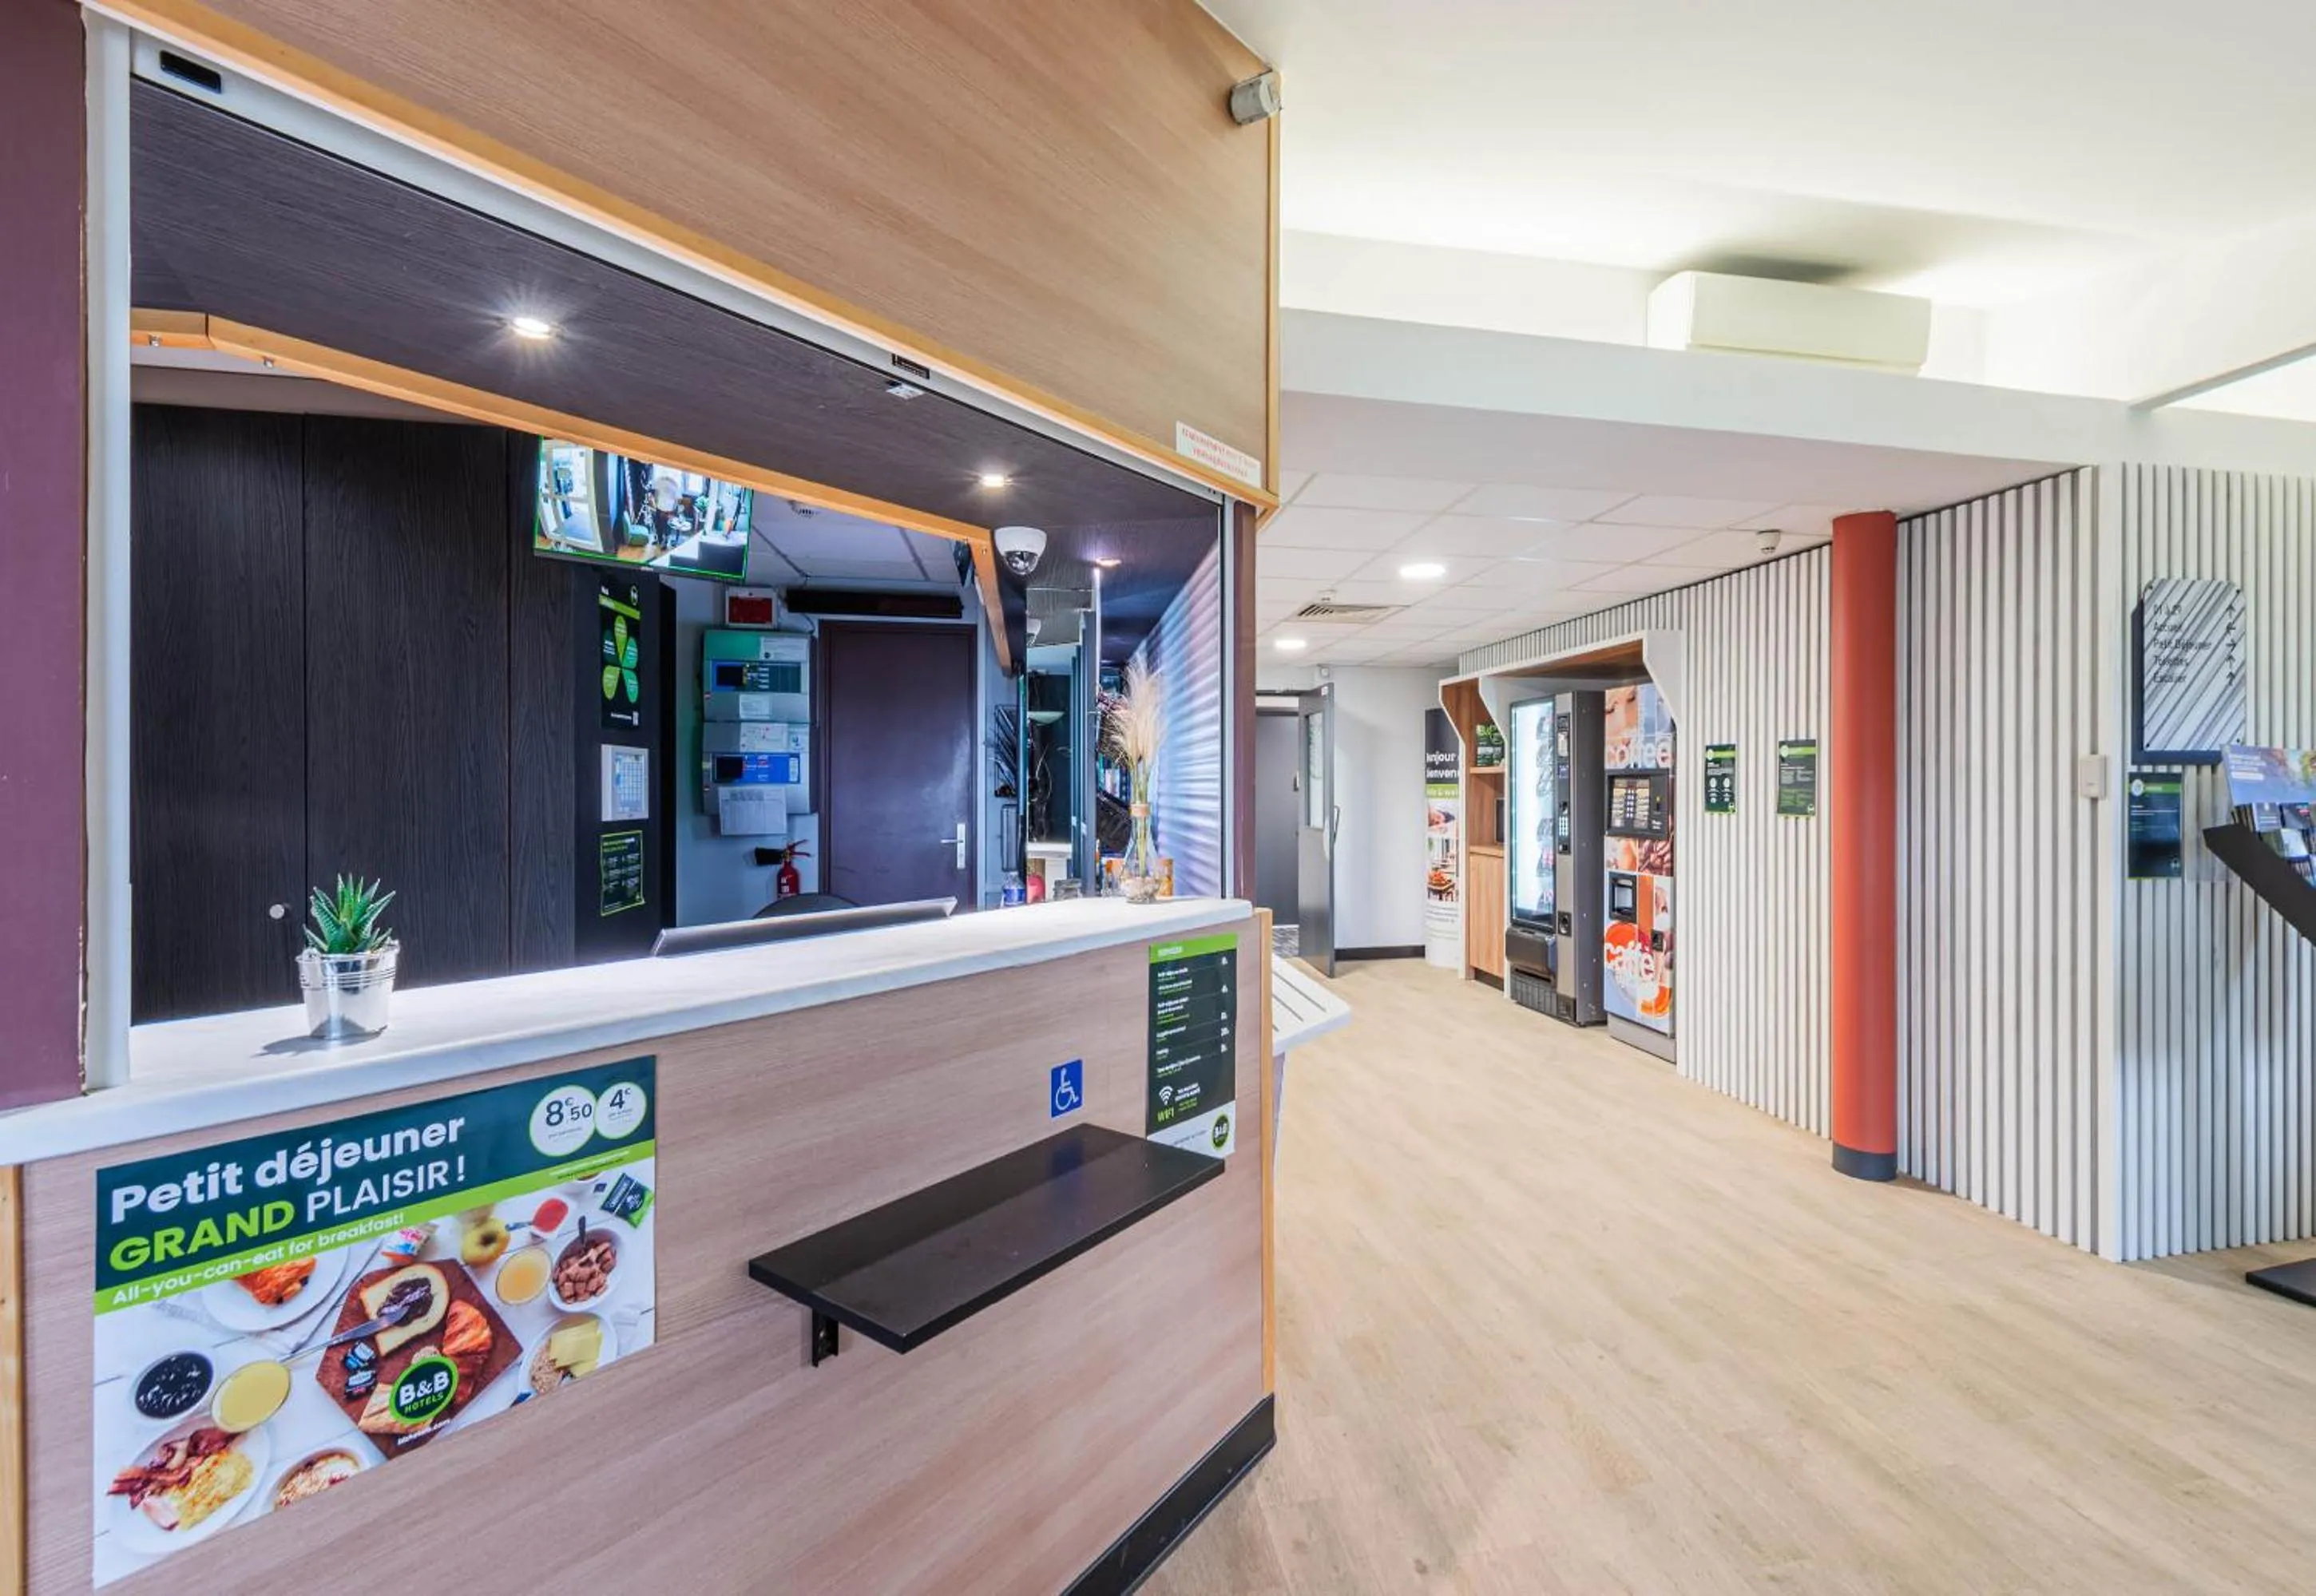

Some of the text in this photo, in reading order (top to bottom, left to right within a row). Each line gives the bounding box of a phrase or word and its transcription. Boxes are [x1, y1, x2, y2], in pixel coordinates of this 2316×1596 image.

[109, 1200, 295, 1272] GRAND
[307, 1159, 449, 1223] PLAISIR
[111, 1117, 466, 1224] Petit déjeuner
[112, 1212, 405, 1305] All-you-can-eat for breakfast!
[399, 1371, 450, 1408] B&B
[403, 1392, 445, 1415] HOTELS
